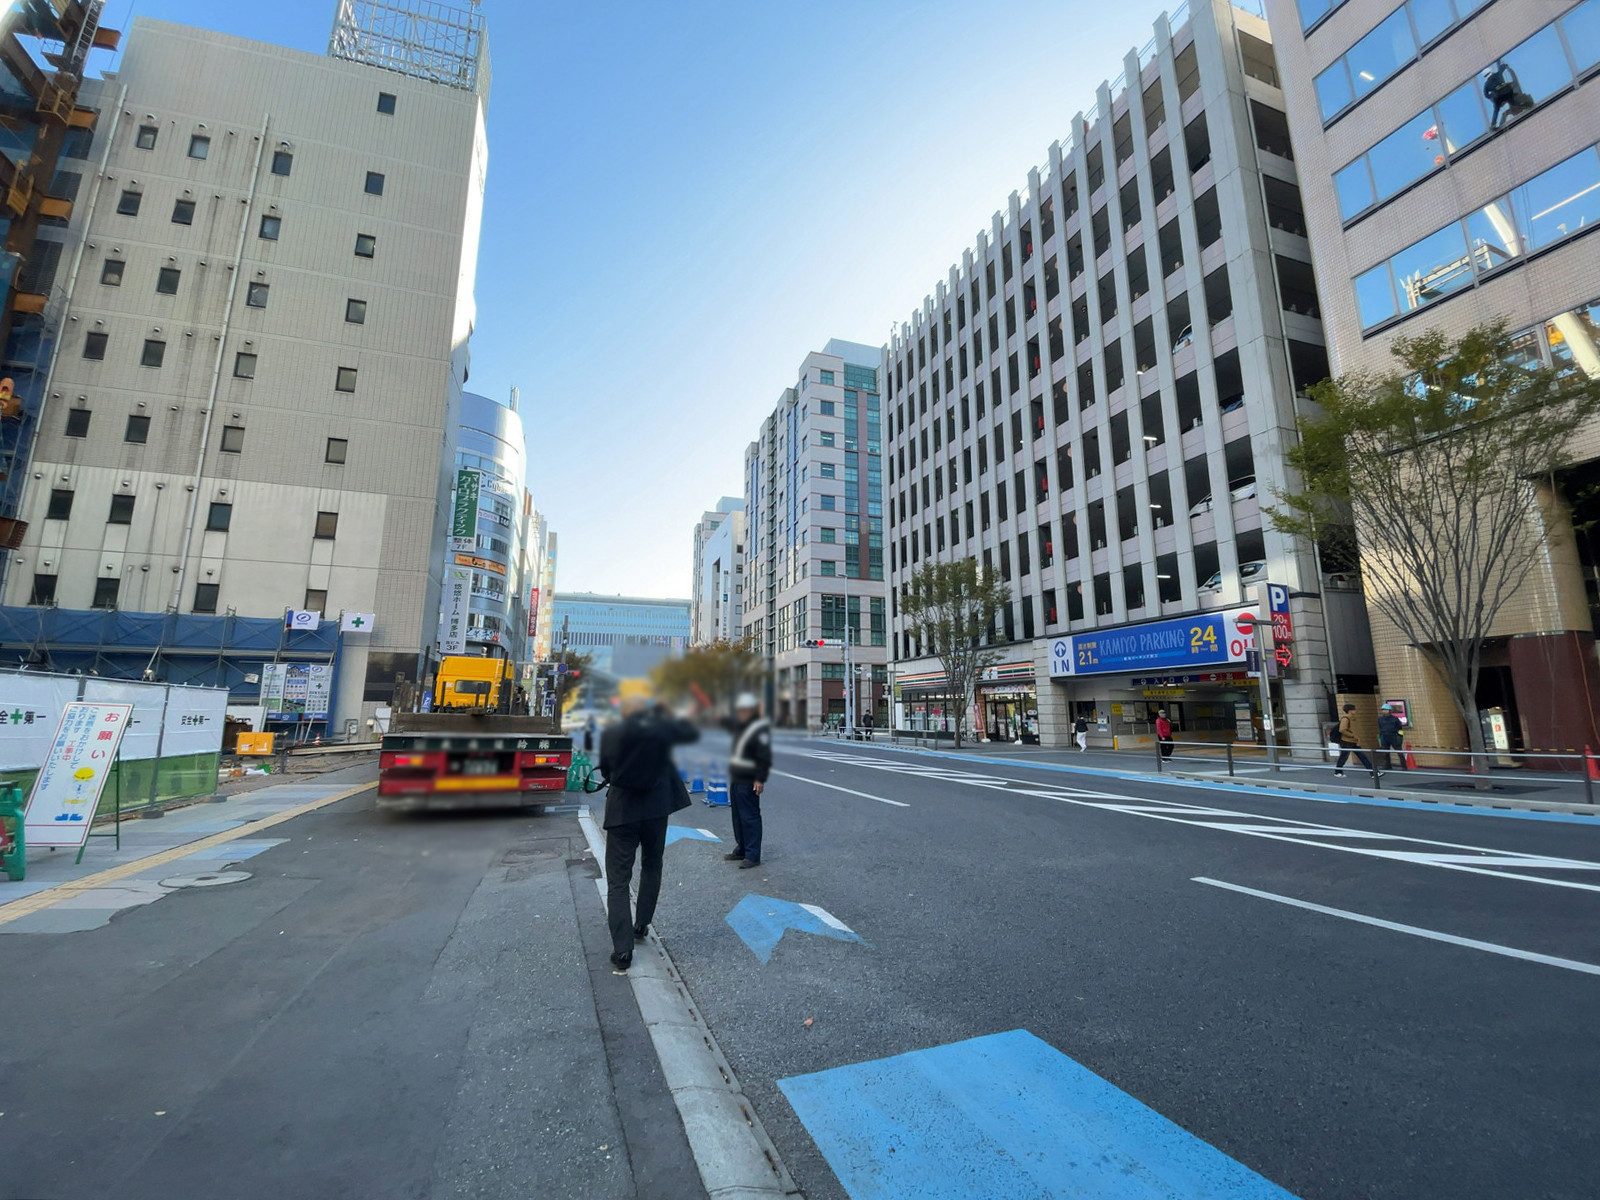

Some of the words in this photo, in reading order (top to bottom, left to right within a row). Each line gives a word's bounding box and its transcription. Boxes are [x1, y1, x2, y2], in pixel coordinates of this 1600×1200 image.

[470, 474, 479, 501] マサキ
[455, 475, 471, 535] カイロプラクティック
[1270, 586, 1285, 611] P
[1100, 636, 1137, 656] KAMIYO
[1140, 628, 1185, 651] PARKING
[1190, 625, 1217, 646] 24
[1053, 659, 1070, 673] IN
[74, 706, 89, 734] おります
[91, 712, 120, 760] お願い
[62, 740, 78, 761] 工事中
